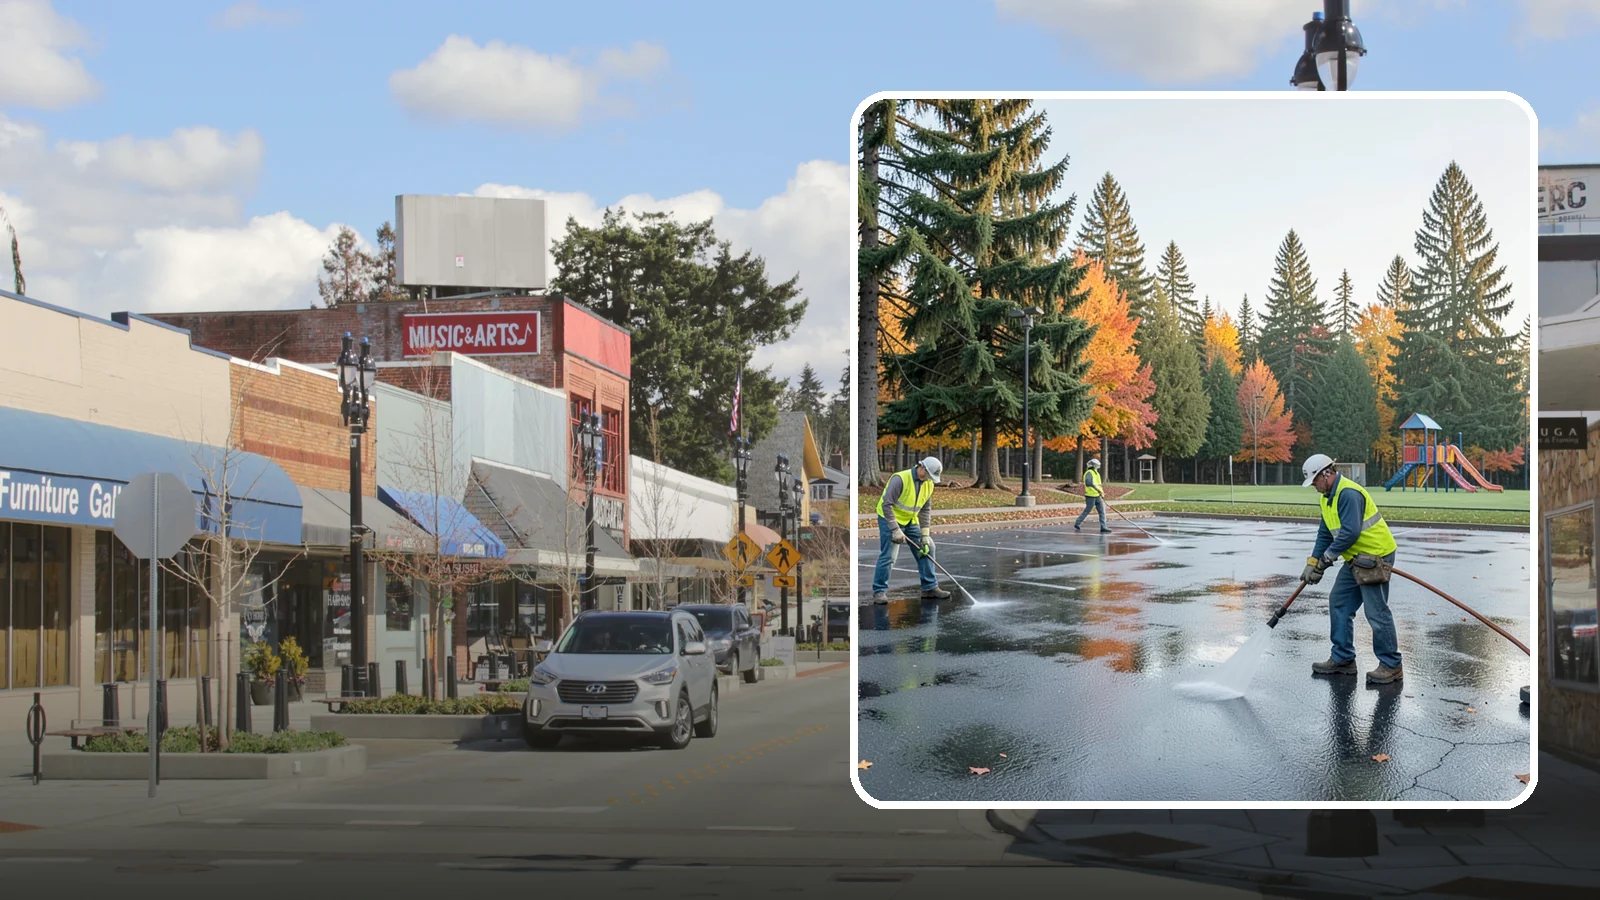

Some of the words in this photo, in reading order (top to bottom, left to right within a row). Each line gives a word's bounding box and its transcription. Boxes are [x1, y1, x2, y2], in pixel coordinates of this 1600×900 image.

[1540, 427, 1577, 437] UGA
[0, 471, 79, 515] Furniture
[89, 482, 122, 519] Gal
